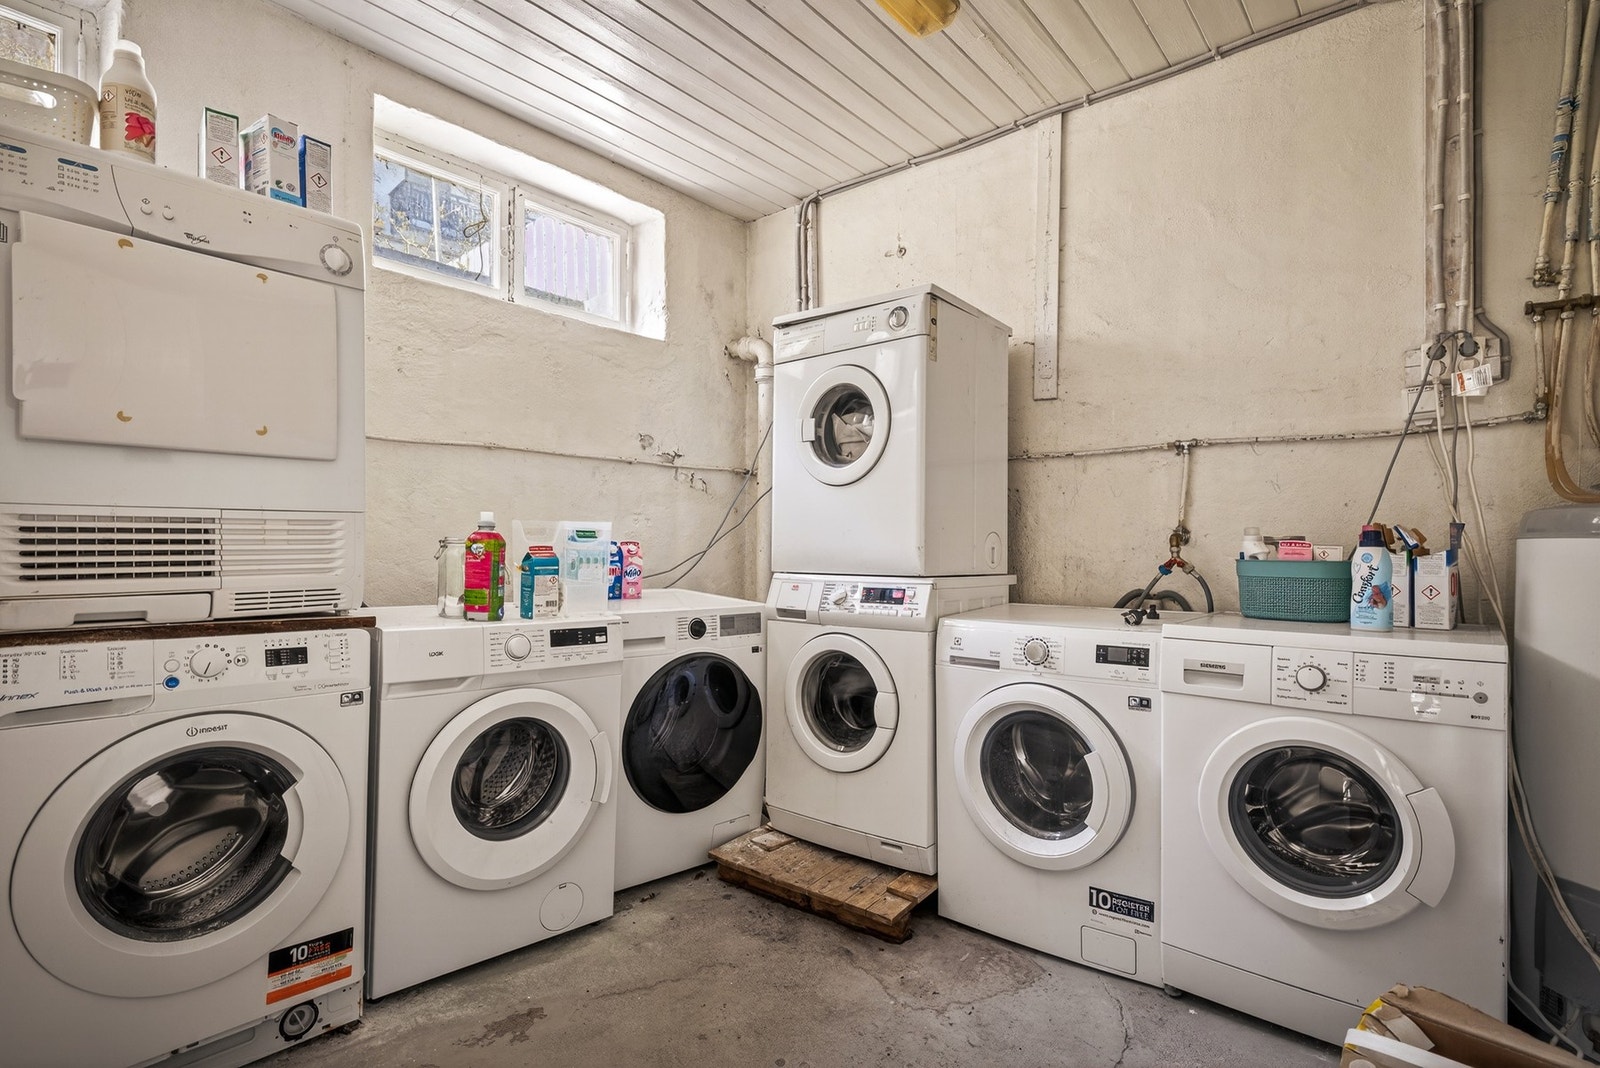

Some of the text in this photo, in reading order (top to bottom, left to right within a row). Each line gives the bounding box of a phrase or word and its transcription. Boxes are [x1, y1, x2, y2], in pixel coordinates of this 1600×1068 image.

[1352, 564, 1379, 604] Comfort
[1090, 889, 1111, 910] 10
[290, 945, 308, 963] 10
